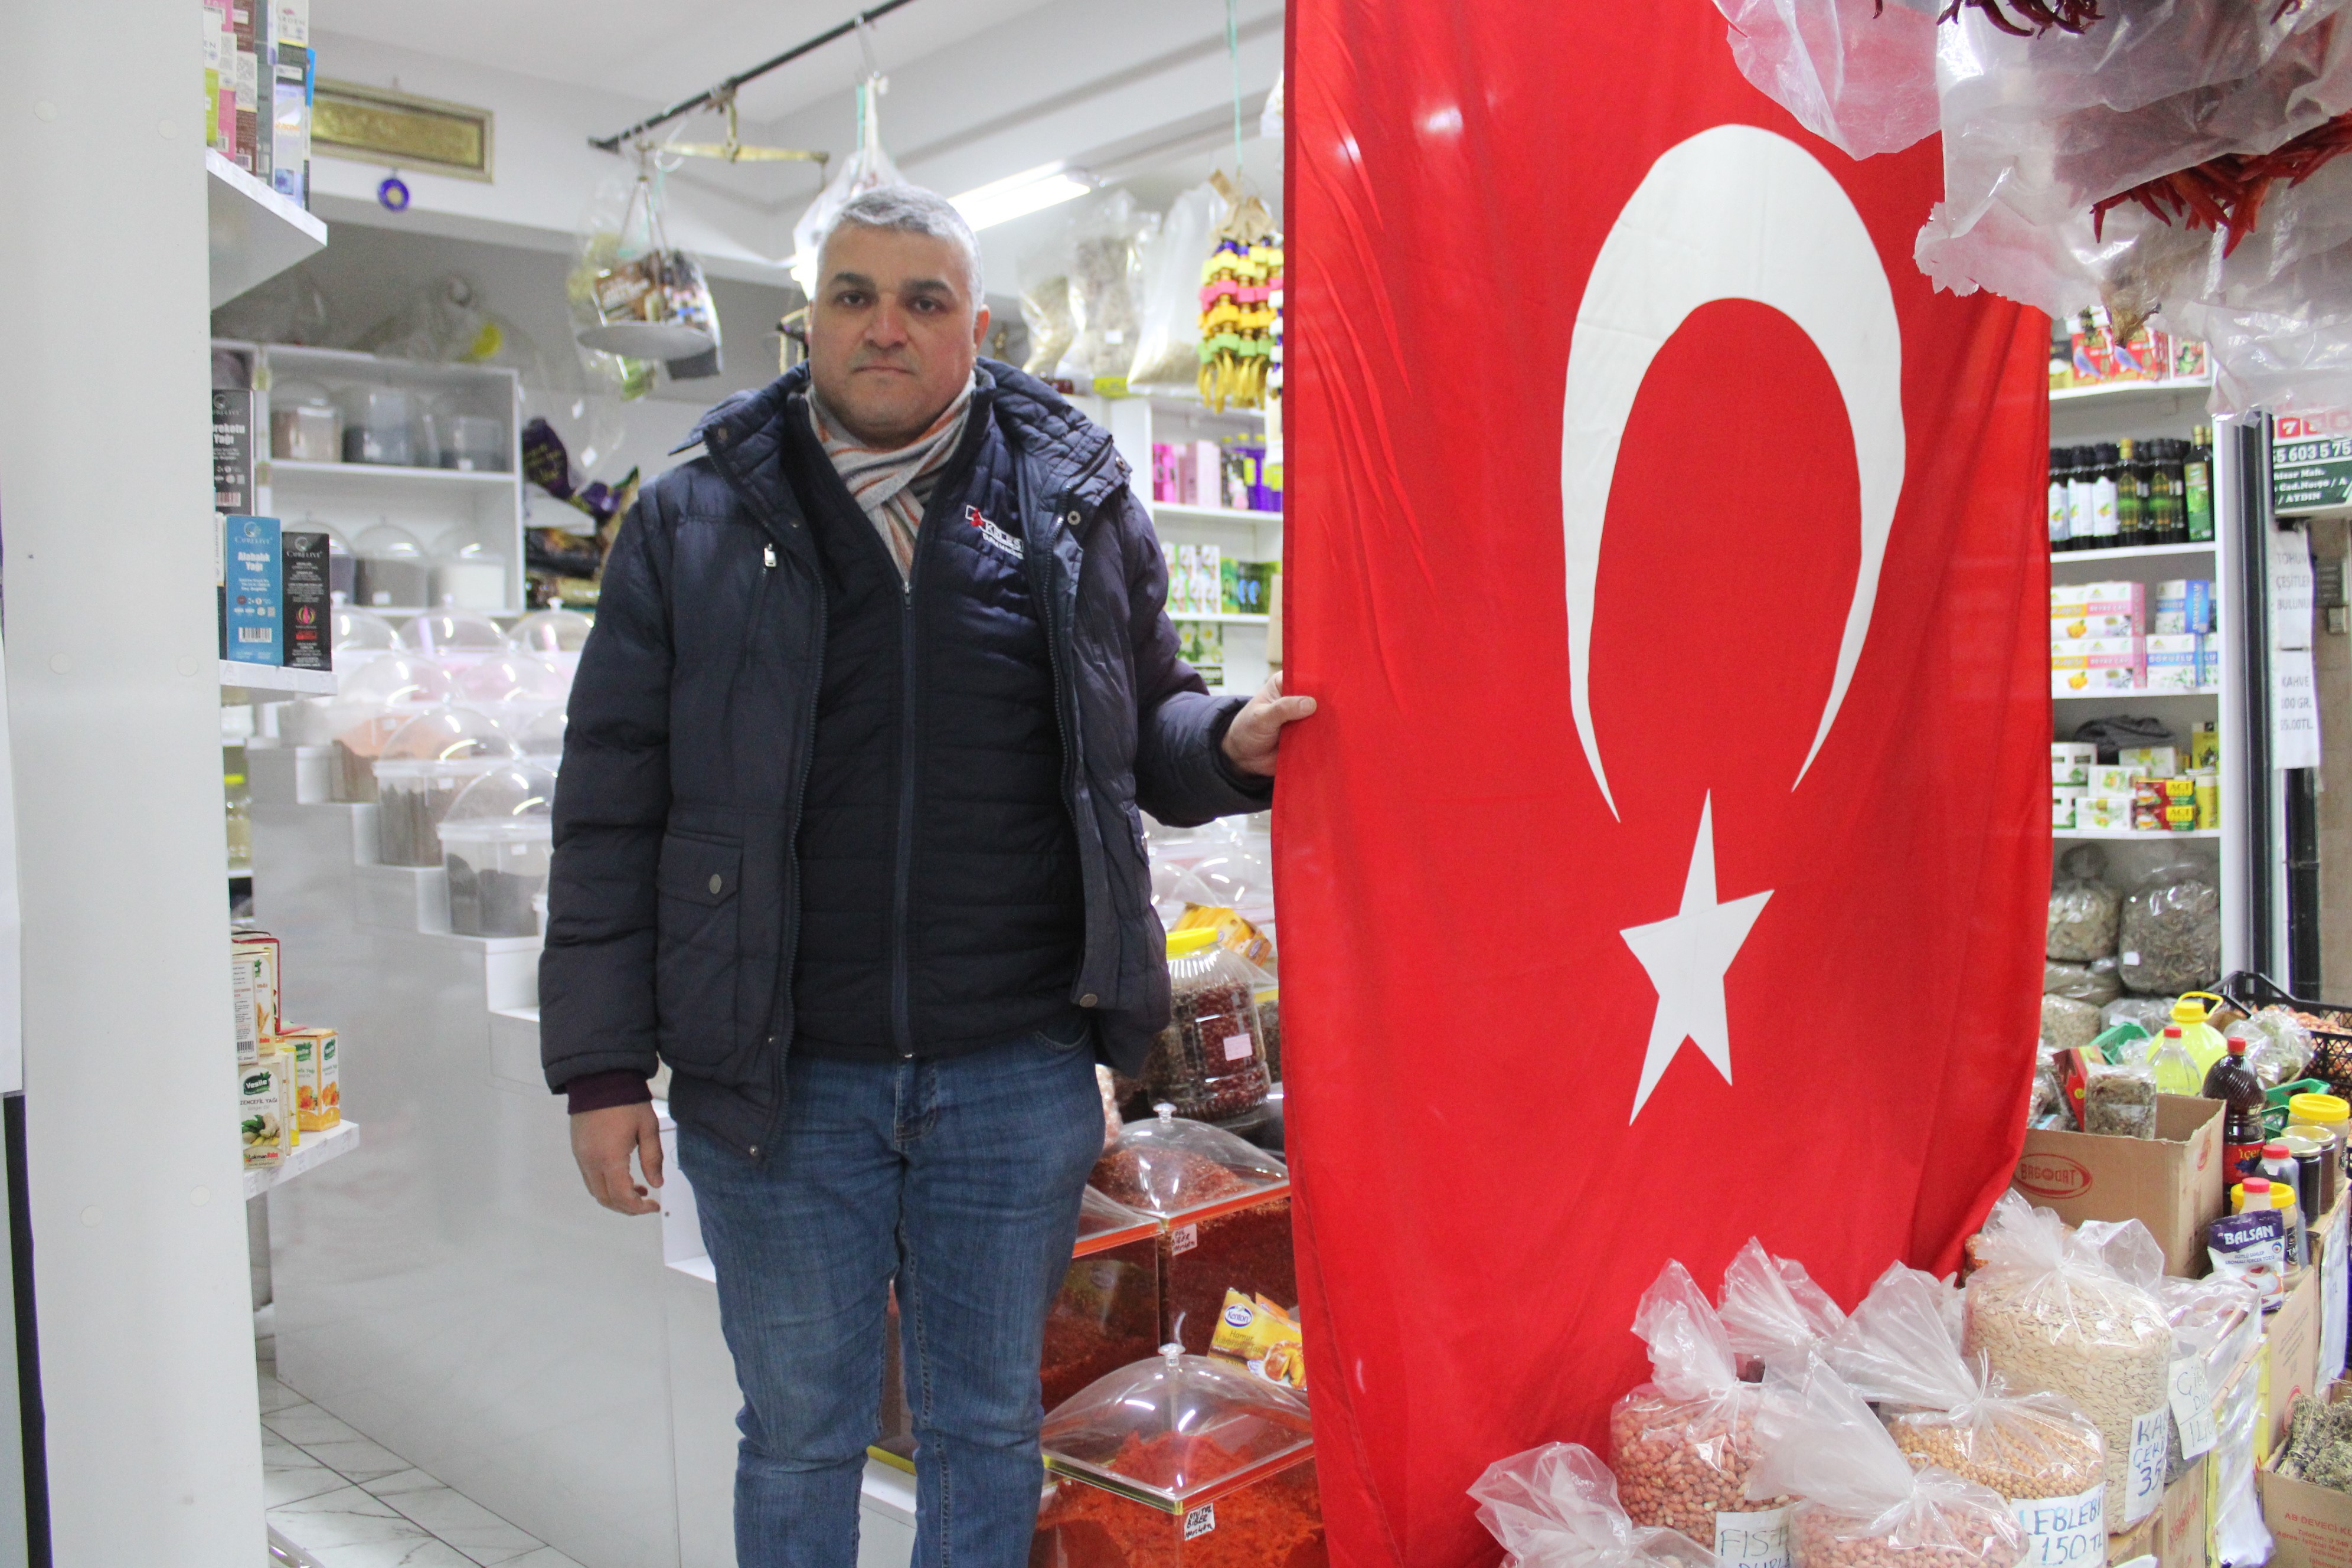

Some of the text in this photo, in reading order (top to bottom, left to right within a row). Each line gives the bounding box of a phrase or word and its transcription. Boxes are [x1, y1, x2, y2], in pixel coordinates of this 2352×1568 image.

[2288, 445, 2317, 462] 603
[2277, 599, 2309, 610] BULUNU
[246, 1079, 267, 1089] Vesile
[2223, 1225, 2274, 1246] BALSAN
[1227, 1311, 1249, 1324] Kenton
[1229, 1329, 1254, 1341] Hamur
[2284, 1513, 2298, 1521] AB
[2041, 1531, 2103, 1564] 150 TL
